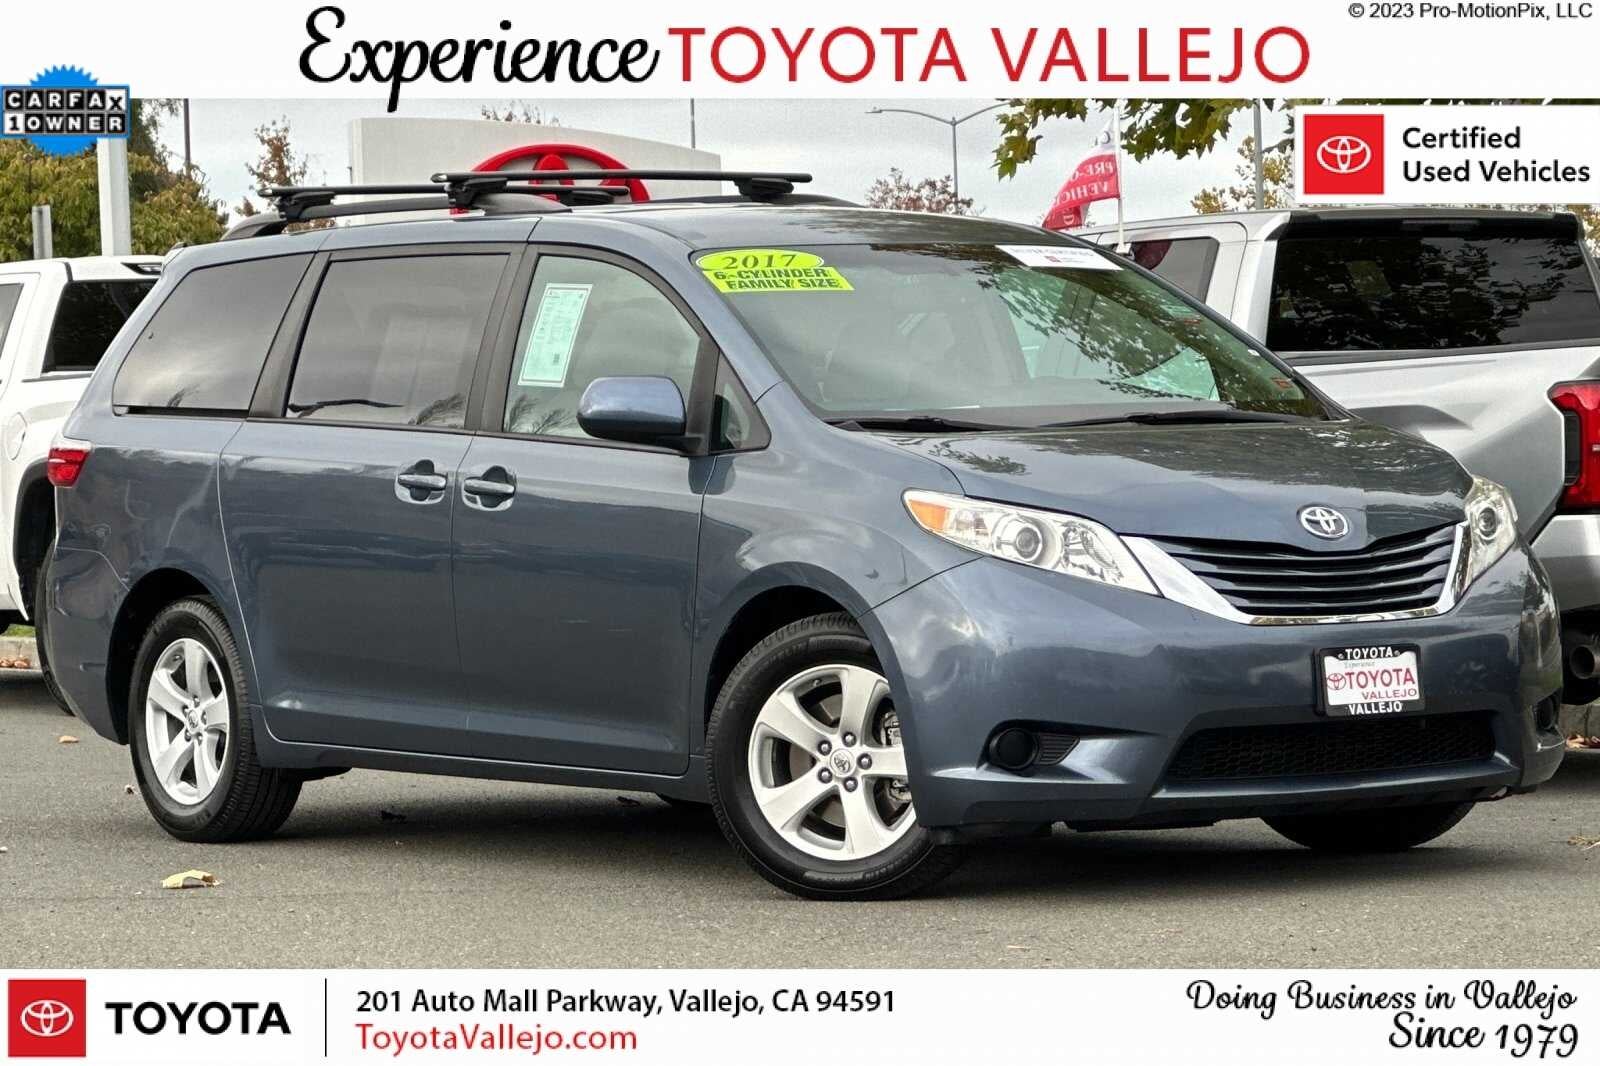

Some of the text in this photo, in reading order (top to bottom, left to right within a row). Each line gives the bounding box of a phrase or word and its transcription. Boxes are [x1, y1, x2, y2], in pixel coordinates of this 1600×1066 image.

[720, 254, 797, 270] 2017
[726, 279, 841, 290] FAMILY SIZE
[1345, 646, 1393, 660] TOYOTA
[1344, 668, 1415, 690] TOYOTA
[1362, 688, 1417, 700] VALLEJO
[1348, 700, 1403, 715] VALLEJO
